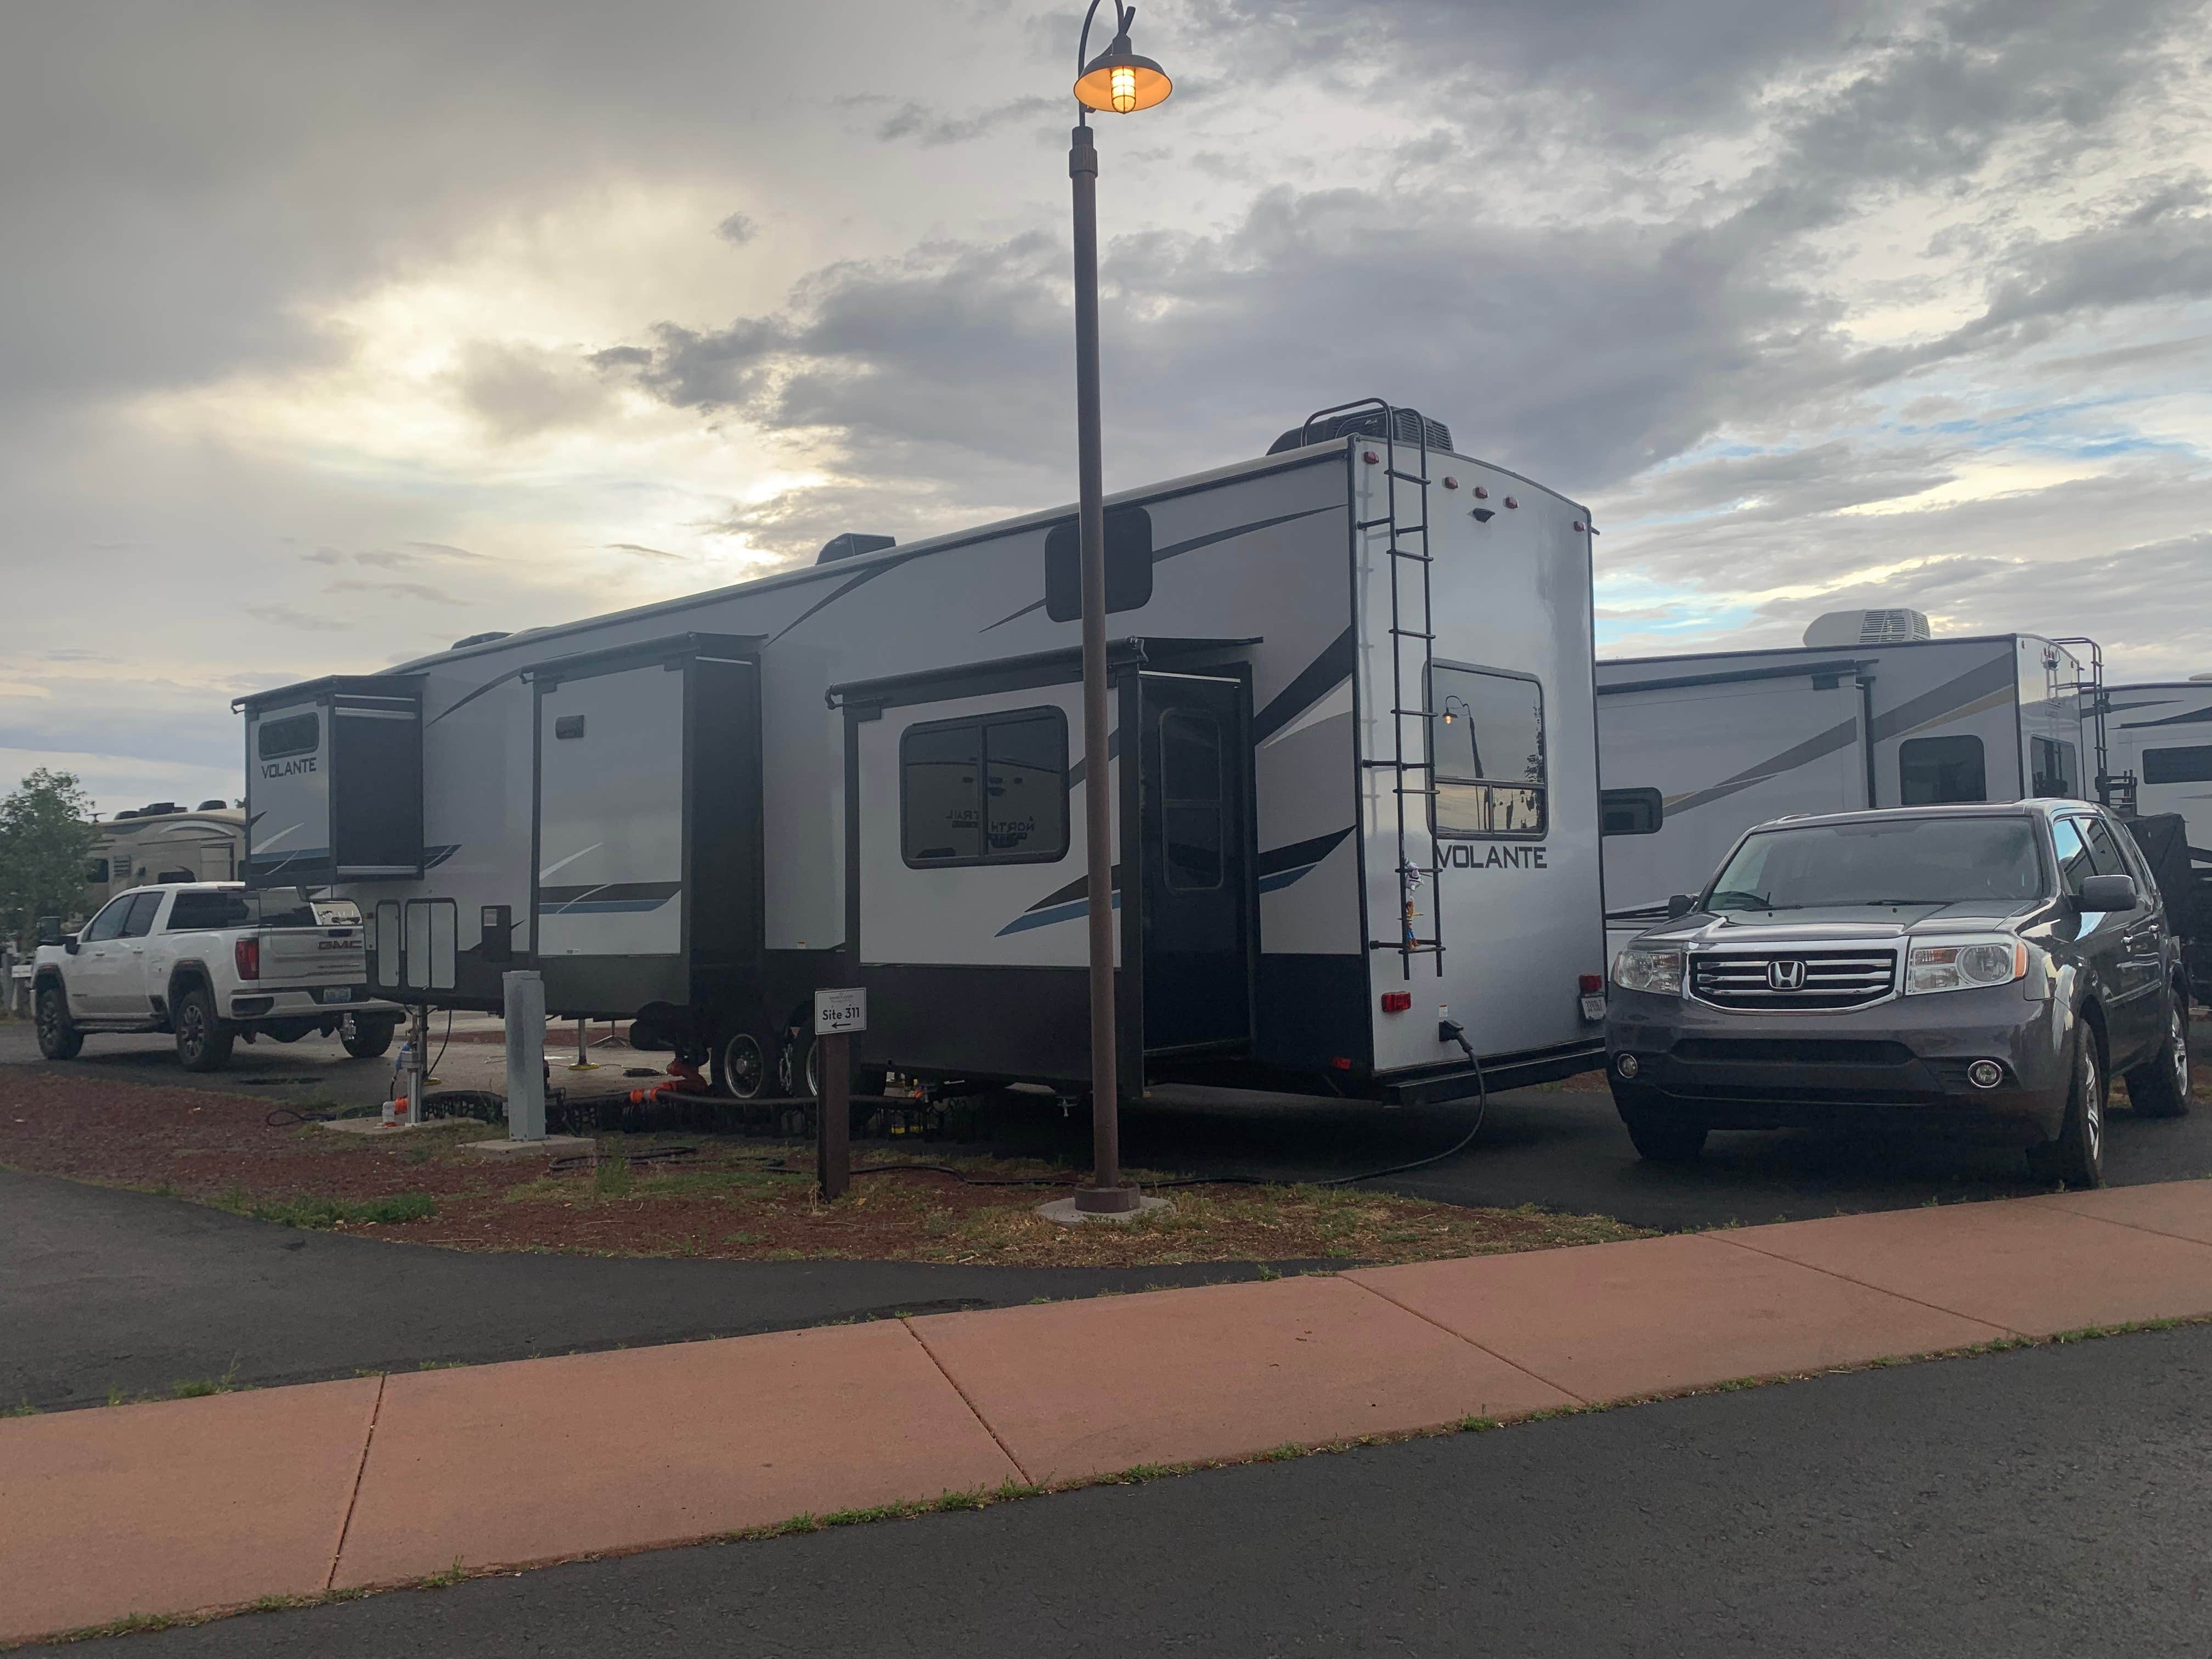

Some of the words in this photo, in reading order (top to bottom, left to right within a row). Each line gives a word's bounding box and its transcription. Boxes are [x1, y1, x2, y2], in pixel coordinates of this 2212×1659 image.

[261, 757, 317, 778] VOLANTE
[1437, 845, 1547, 868] VOLANTE
[318, 940, 363, 950] GMC
[822, 1009, 843, 1020] Site
[845, 1007, 860, 1018] 311
